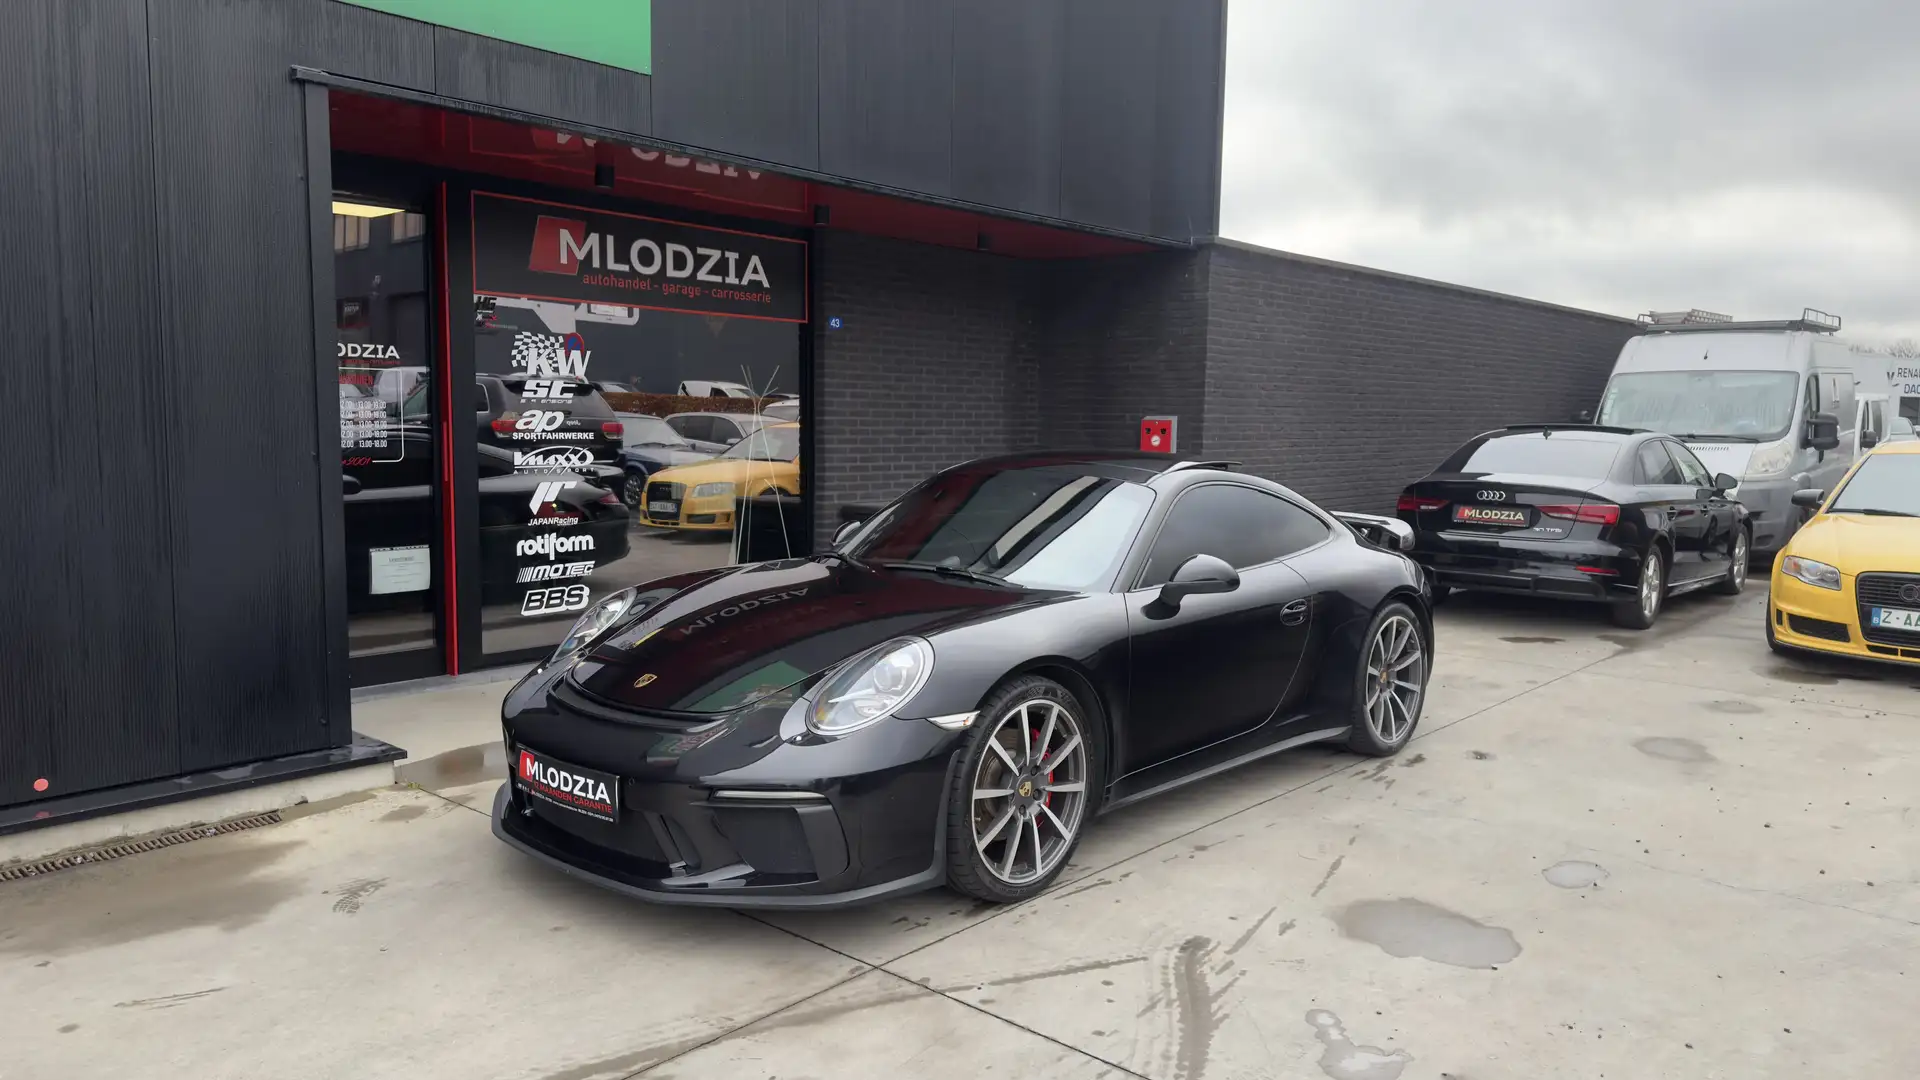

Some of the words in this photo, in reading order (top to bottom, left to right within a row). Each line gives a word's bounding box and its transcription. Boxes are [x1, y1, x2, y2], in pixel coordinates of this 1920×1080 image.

[559, 228, 770, 288] MLODZIA
[583, 273, 651, 291] autohandel
[662, 282, 701, 297] garage
[711, 288, 771, 303] carrosserie
[830, 318, 840, 328] 43
[526, 347, 592, 377] KW
[1897, 368, 1920, 378] RENA
[515, 409, 565, 433] ap
[512, 432, 595, 441] SPORTFAHRWERKE
[1464, 509, 1524, 521] MLODZIA
[516, 532, 595, 560] rotiform
[521, 584, 590, 617] BBS
[526, 757, 612, 804] MLODZIA
[573, 795, 613, 814] GARANTIE
